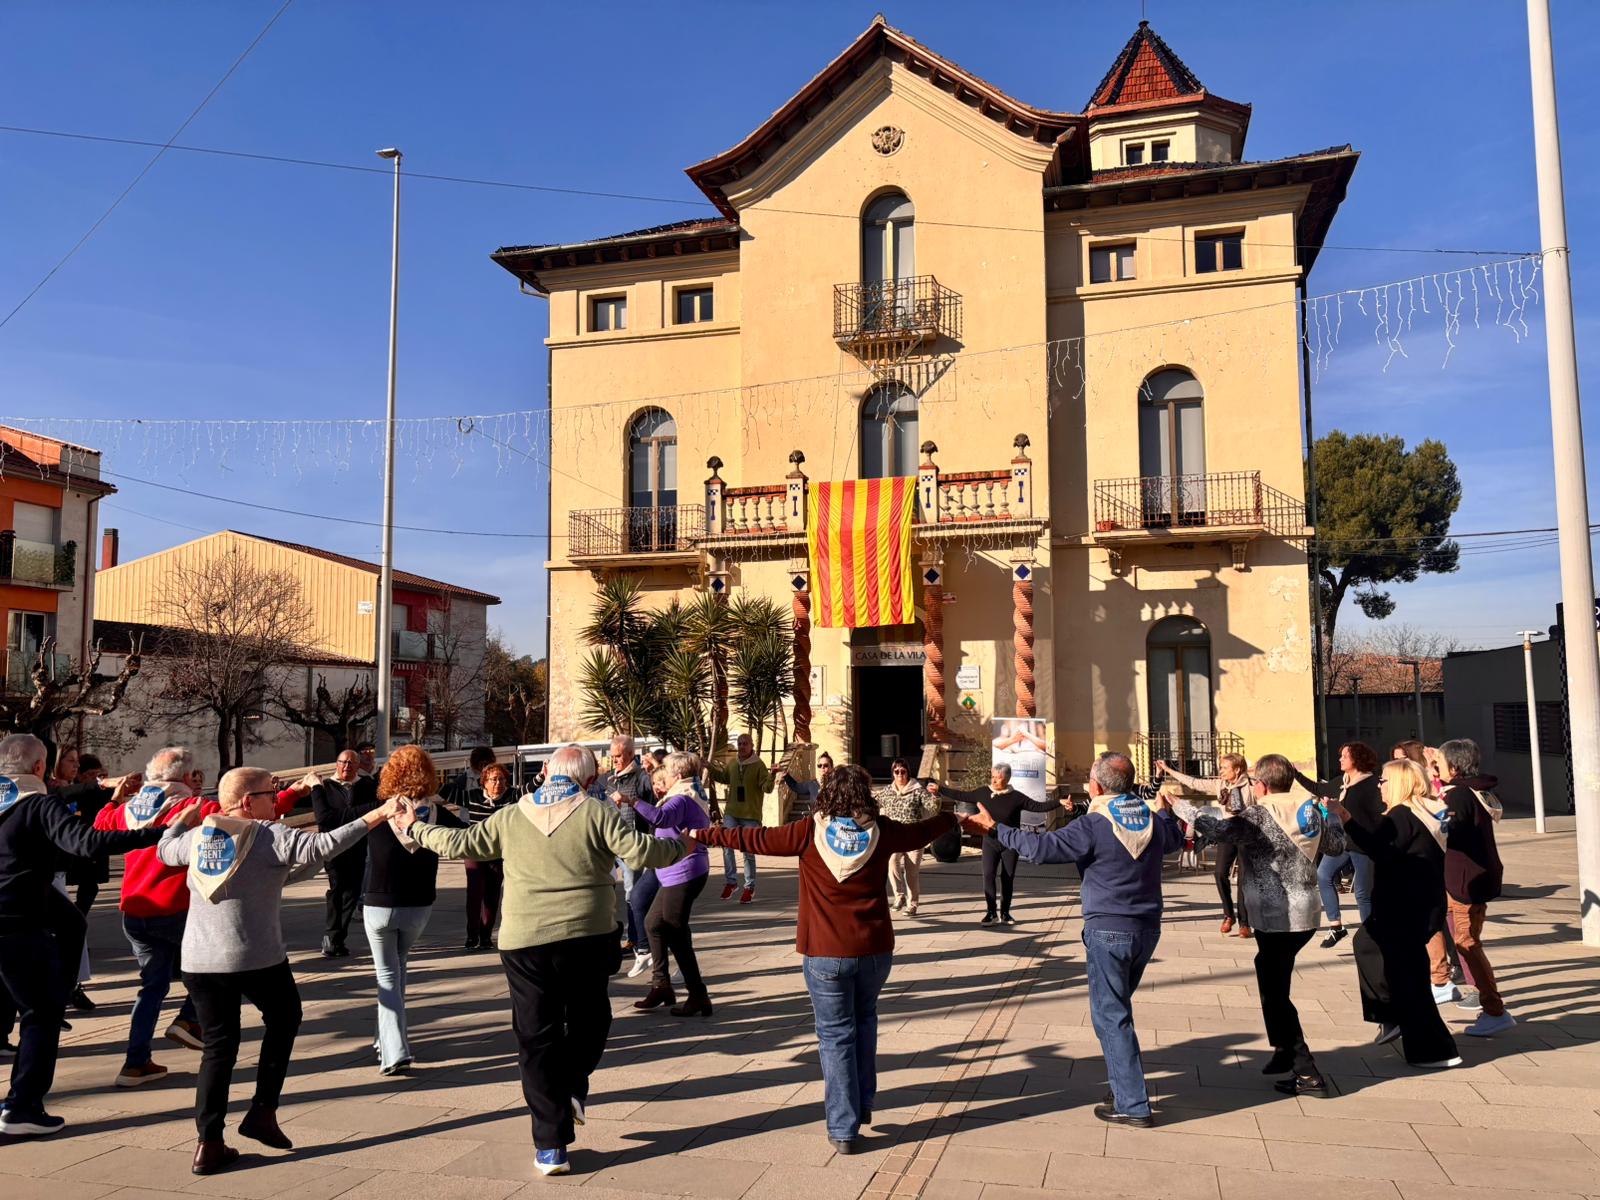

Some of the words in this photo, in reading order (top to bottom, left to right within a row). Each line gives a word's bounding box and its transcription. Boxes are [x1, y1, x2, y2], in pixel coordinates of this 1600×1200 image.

[855, 651, 878, 660] CASA
[880, 651, 893, 660] DE
[894, 651, 905, 660] LA
[907, 651, 927, 660] VILA
